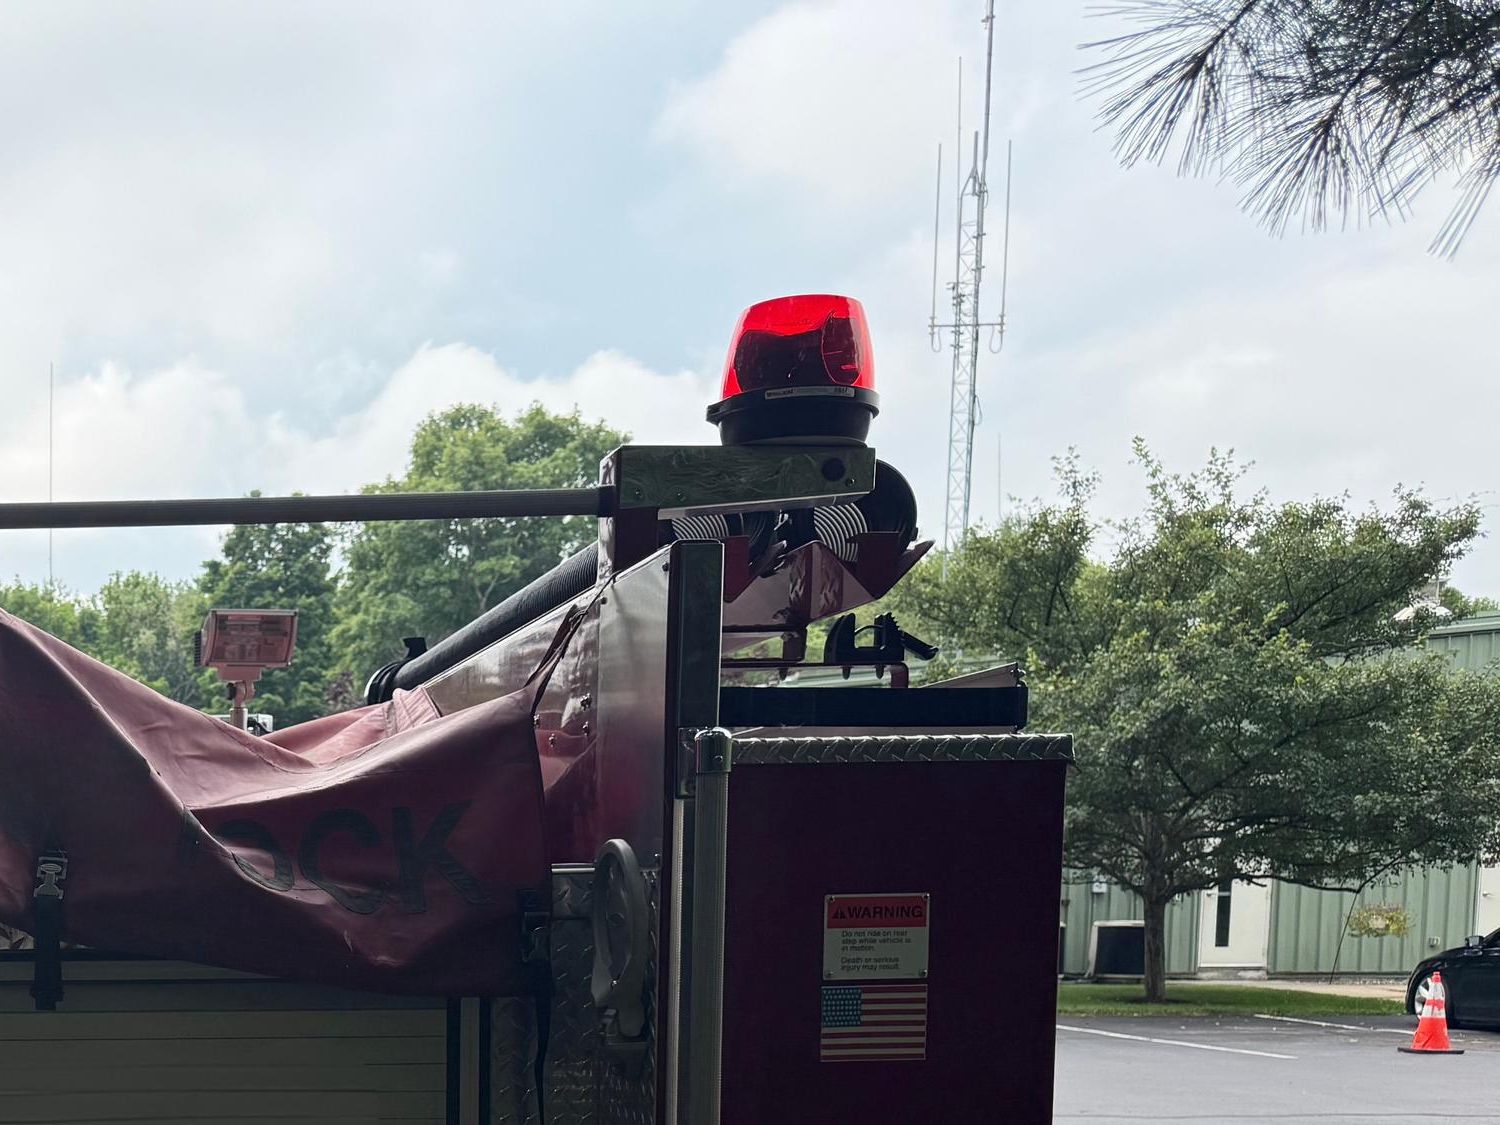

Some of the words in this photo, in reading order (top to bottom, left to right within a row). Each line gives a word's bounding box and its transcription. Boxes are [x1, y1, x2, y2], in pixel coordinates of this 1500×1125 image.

[847, 904, 923, 919] WARNING
[842, 930, 853, 938] Do
[854, 930, 866, 938] not
[842, 937, 857, 945] step
[841, 964, 861, 972] injury
